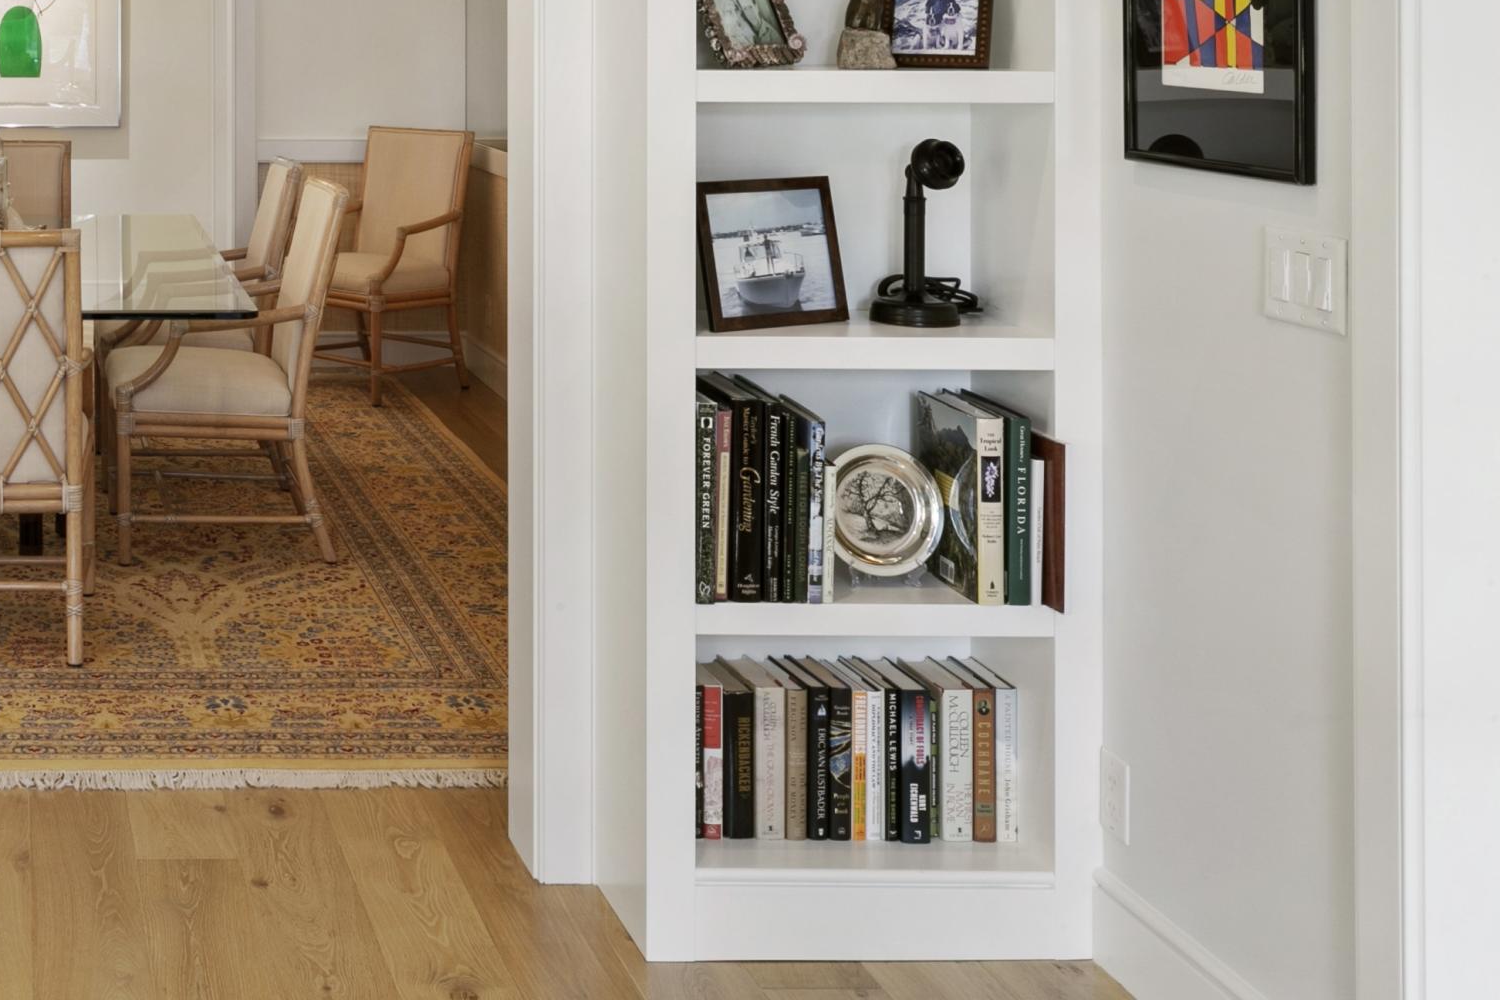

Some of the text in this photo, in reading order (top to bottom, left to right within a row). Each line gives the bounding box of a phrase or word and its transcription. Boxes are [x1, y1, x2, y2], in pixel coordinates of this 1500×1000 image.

[770, 415, 780, 447] French
[814, 427, 824, 460] Gardens
[702, 437, 711, 528] FOREVER GREEN
[739, 467, 761, 533] Gardening
[770, 450, 780, 486] Garden
[1017, 467, 1026, 535] FLORIDA
[767, 490, 780, 515] Style
[798, 471, 808, 583] TREES FOR SOUTH FLORIDA
[738, 716, 751, 793] RICKENBACKER
[915, 695, 924, 765] CONSPIRACY OF FOOLS
[960, 711, 969, 758] COLLEEN
[978, 722, 991, 794] COCHRANE
[817, 728, 827, 820] ERIC VAN LUSTBADER
[910, 783, 918, 823] EICHENWALD
